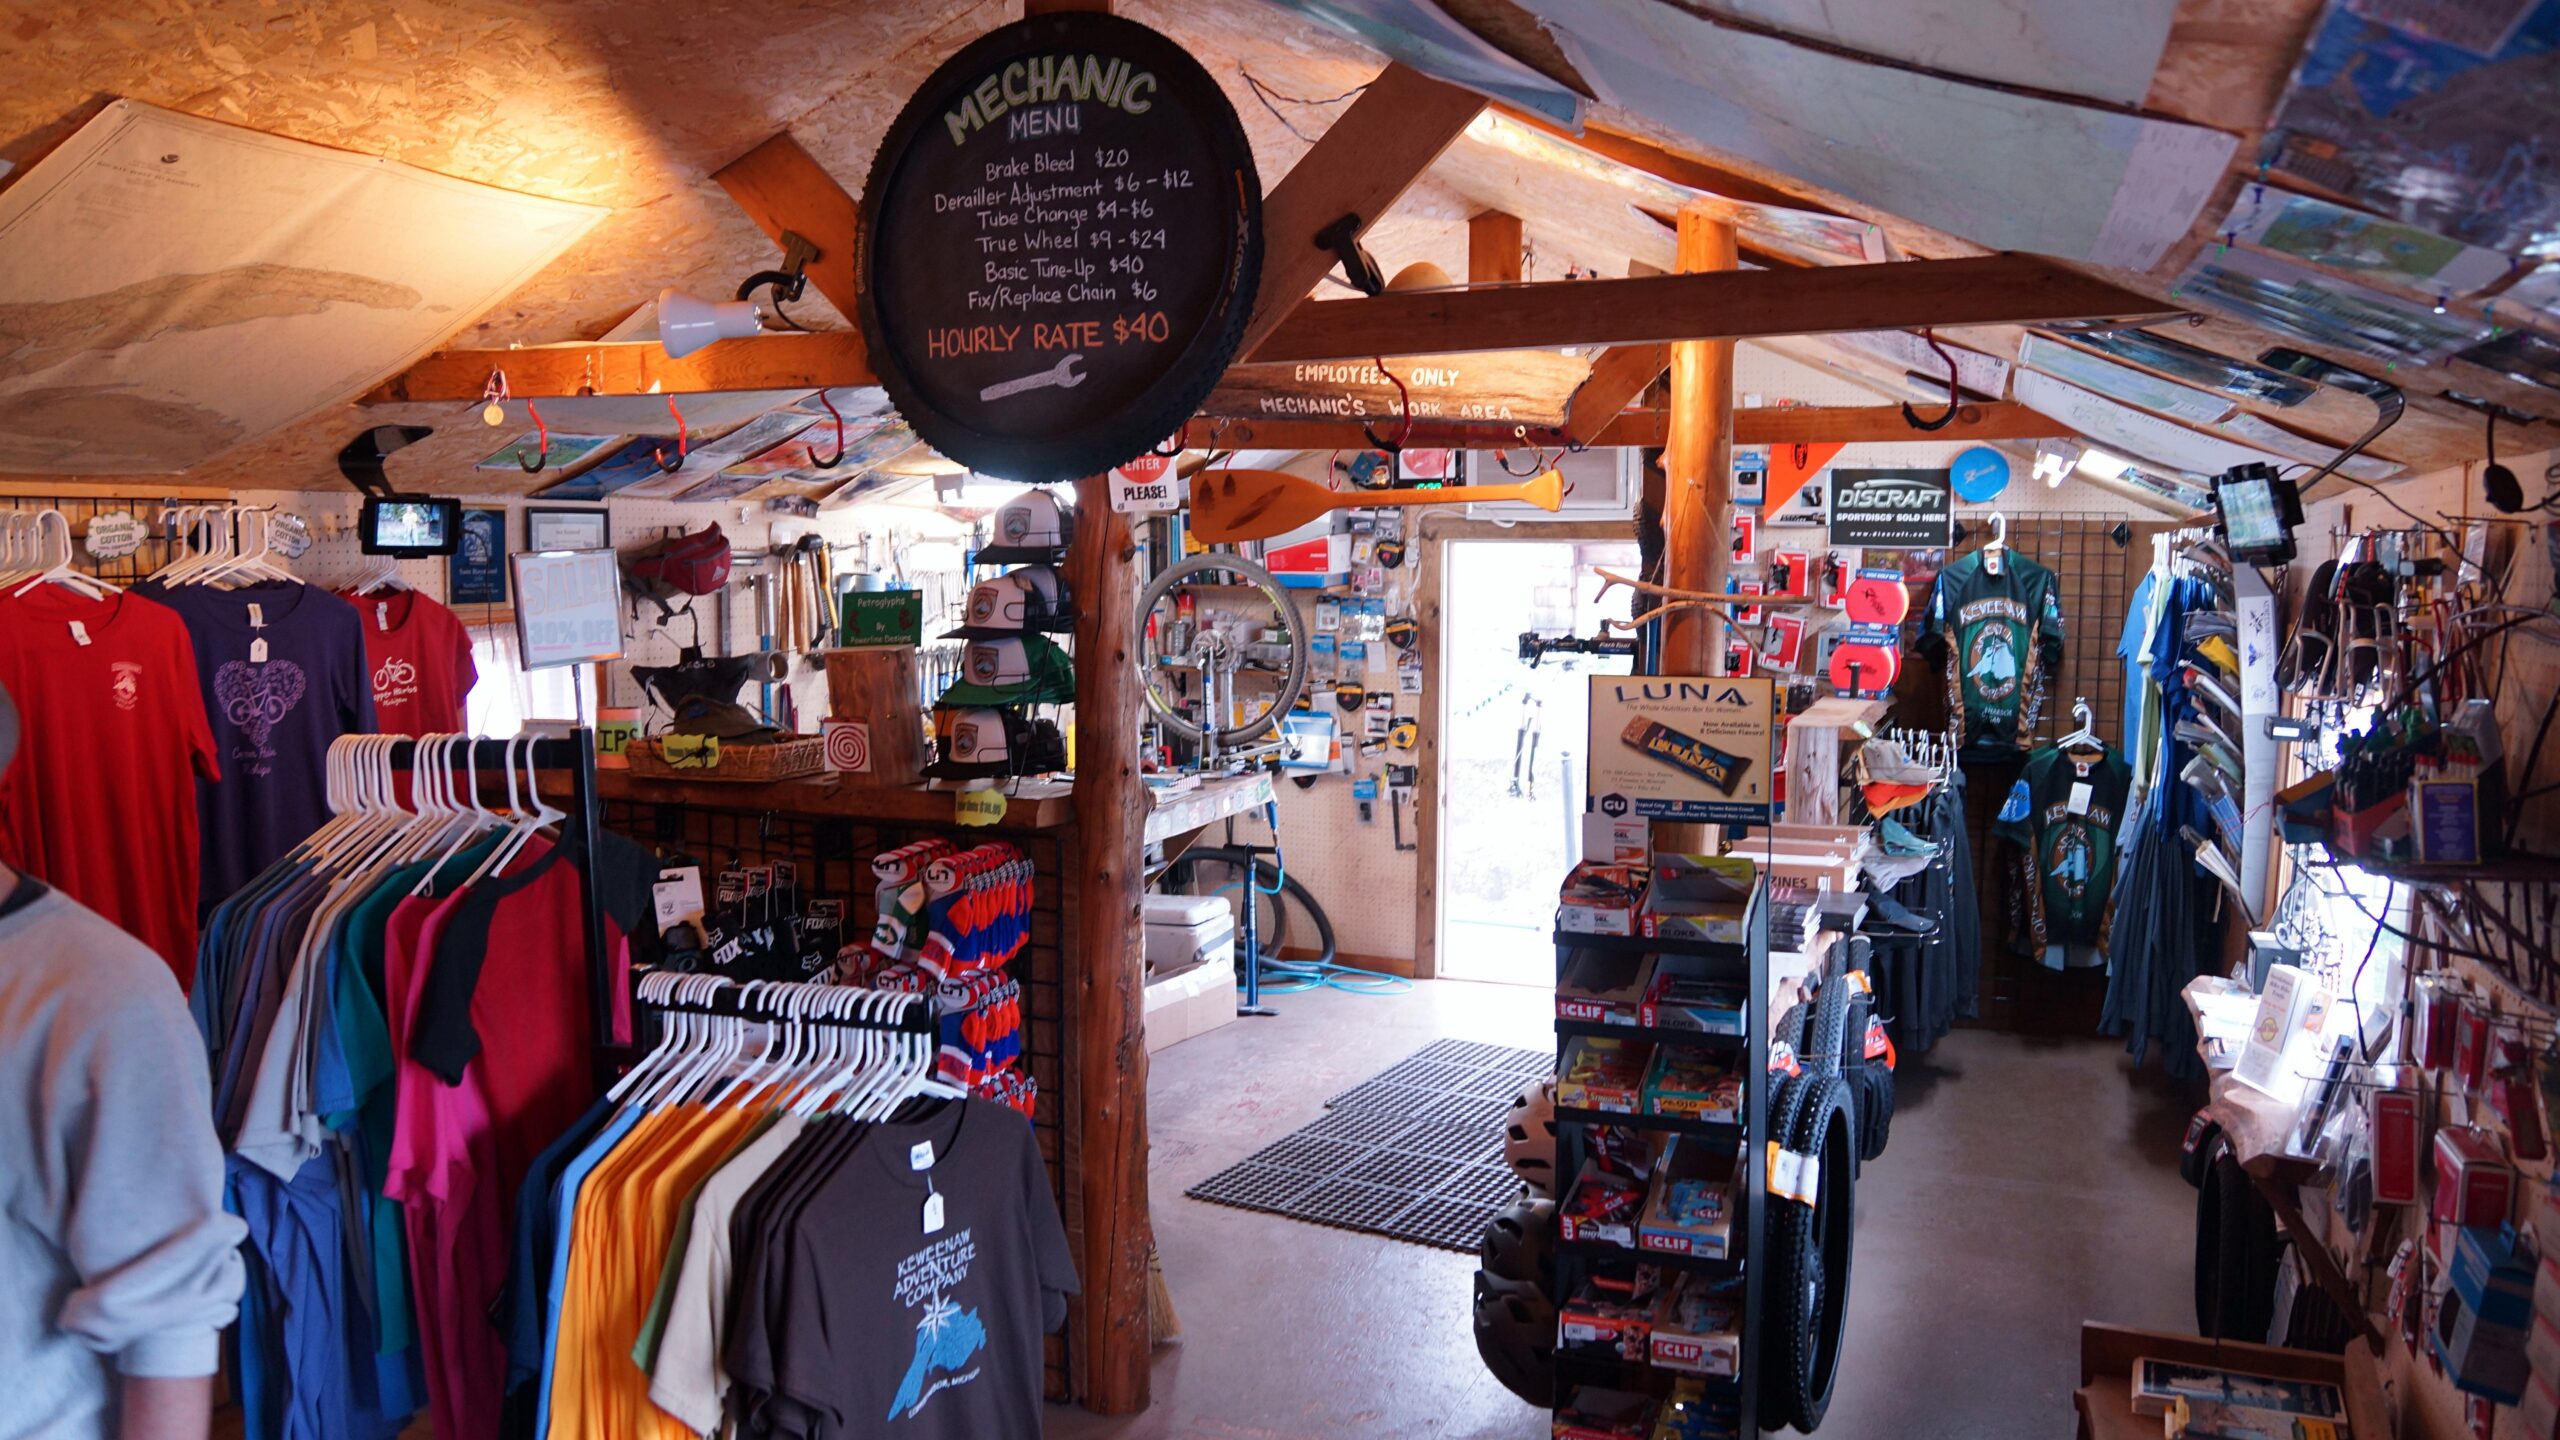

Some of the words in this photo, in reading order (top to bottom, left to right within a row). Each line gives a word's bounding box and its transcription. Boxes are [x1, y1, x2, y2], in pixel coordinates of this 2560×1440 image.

[944, 53, 1157, 146] MECHANIC
[1009, 105, 1080, 141] MENU
[985, 157, 1029, 182] Brake
[1034, 149, 1075, 172] Bleed
[1095, 146, 1129, 168] $20
[934, 186, 1007, 213] Derailler
[1010, 179, 1103, 208] Adjustment
[1115, 173, 1140, 192] $6
[1163, 170, 1193, 190] $12
[976, 210, 1018, 230] Tube
[1024, 206, 1088, 230] Change
[975, 236, 1018, 253] True
[1024, 229, 1078, 249] Wheel
[985, 260, 1029, 283] Basic
[1030, 257, 1096, 283] Tune-Up
[1109, 254, 1144, 275] $40
[968, 284, 1062, 312] Fix/Replace
[1068, 283, 1116, 301] Chain
[1132, 278, 1157, 301] $6
[928, 324, 1021, 359] HOURLY
[1034, 321, 1104, 349] RATE
[1113, 311, 1169, 345] $40
[1295, 365, 1391, 385] EMPLOYEES
[1410, 367, 1460, 387] ONLY
[1260, 393, 1366, 416] MECHANIC'S
[1388, 400, 1443, 417] WORK
[1459, 403, 1513, 420] AREA
[1125, 457, 1160, 472] ENTER
[1124, 485, 1168, 501] PLEASE!
[1837, 489, 1946, 509] DISCRAFT
[1896, 513, 1921, 522] SOLD
[1921, 513, 1947, 522] HERE
[95, 524, 135, 536] ORGANIC
[274, 519, 306, 538] ORGANIC
[274, 530, 302, 545] COTTON
[100, 533, 133, 545] COTTON
[857, 596, 906, 609] Petroglyphs
[530, 618, 578, 645] 30%
[581, 618, 615, 643] OFF
[875, 622, 887, 632] By
[884, 634, 912, 643] Designs
[1615, 683, 1748, 706] LUNA
[1640, 704, 1660, 712] Whole
[1661, 705, 1691, 713] Nutrition
[1706, 728, 1737, 736] Delicious
[1603, 800, 1626, 811] GU
[719, 889, 734, 902] FOX
[805, 917, 824, 930] FOX
[712, 936, 743, 966] FOX
[1566, 1005, 1602, 1019] CLIF
[1563, 1216, 1574, 1240] CLIF
[897, 1226, 971, 1278] KEWEENAW
[1653, 1238, 1690, 1251] CLIF
[893, 1241, 977, 1301] ADVENTURE
[906, 1262, 969, 1309] COMPANY
[1664, 1344, 1699, 1359] CLIF
